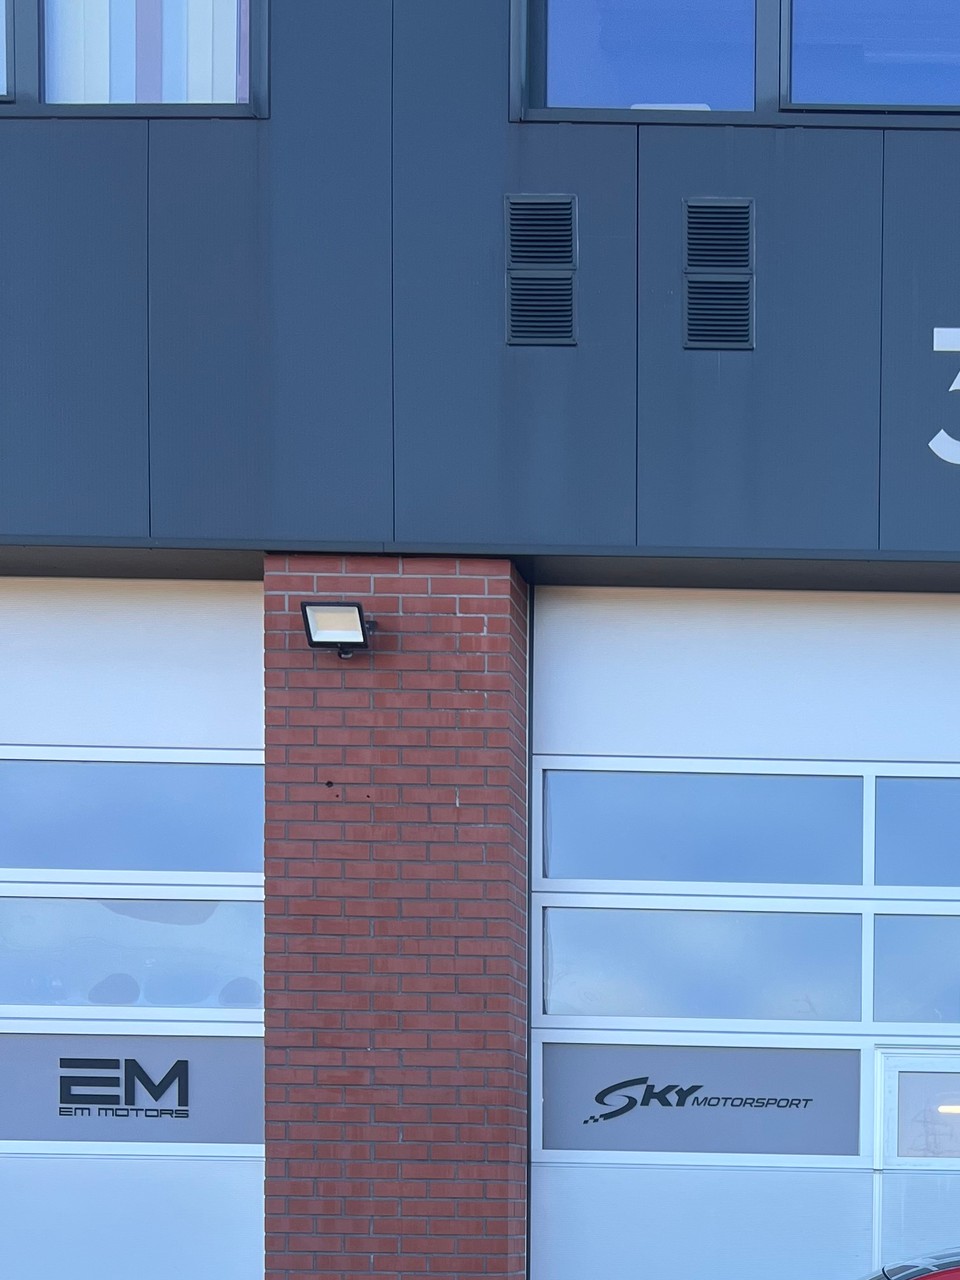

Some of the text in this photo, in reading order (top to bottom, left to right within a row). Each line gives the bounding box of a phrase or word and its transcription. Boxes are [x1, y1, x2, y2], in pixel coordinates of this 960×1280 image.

[59, 1057, 189, 1107] EM
[583, 1076, 813, 1124] SKY MOTORSPORT
[58, 1107, 189, 1119] EM MOTORS
